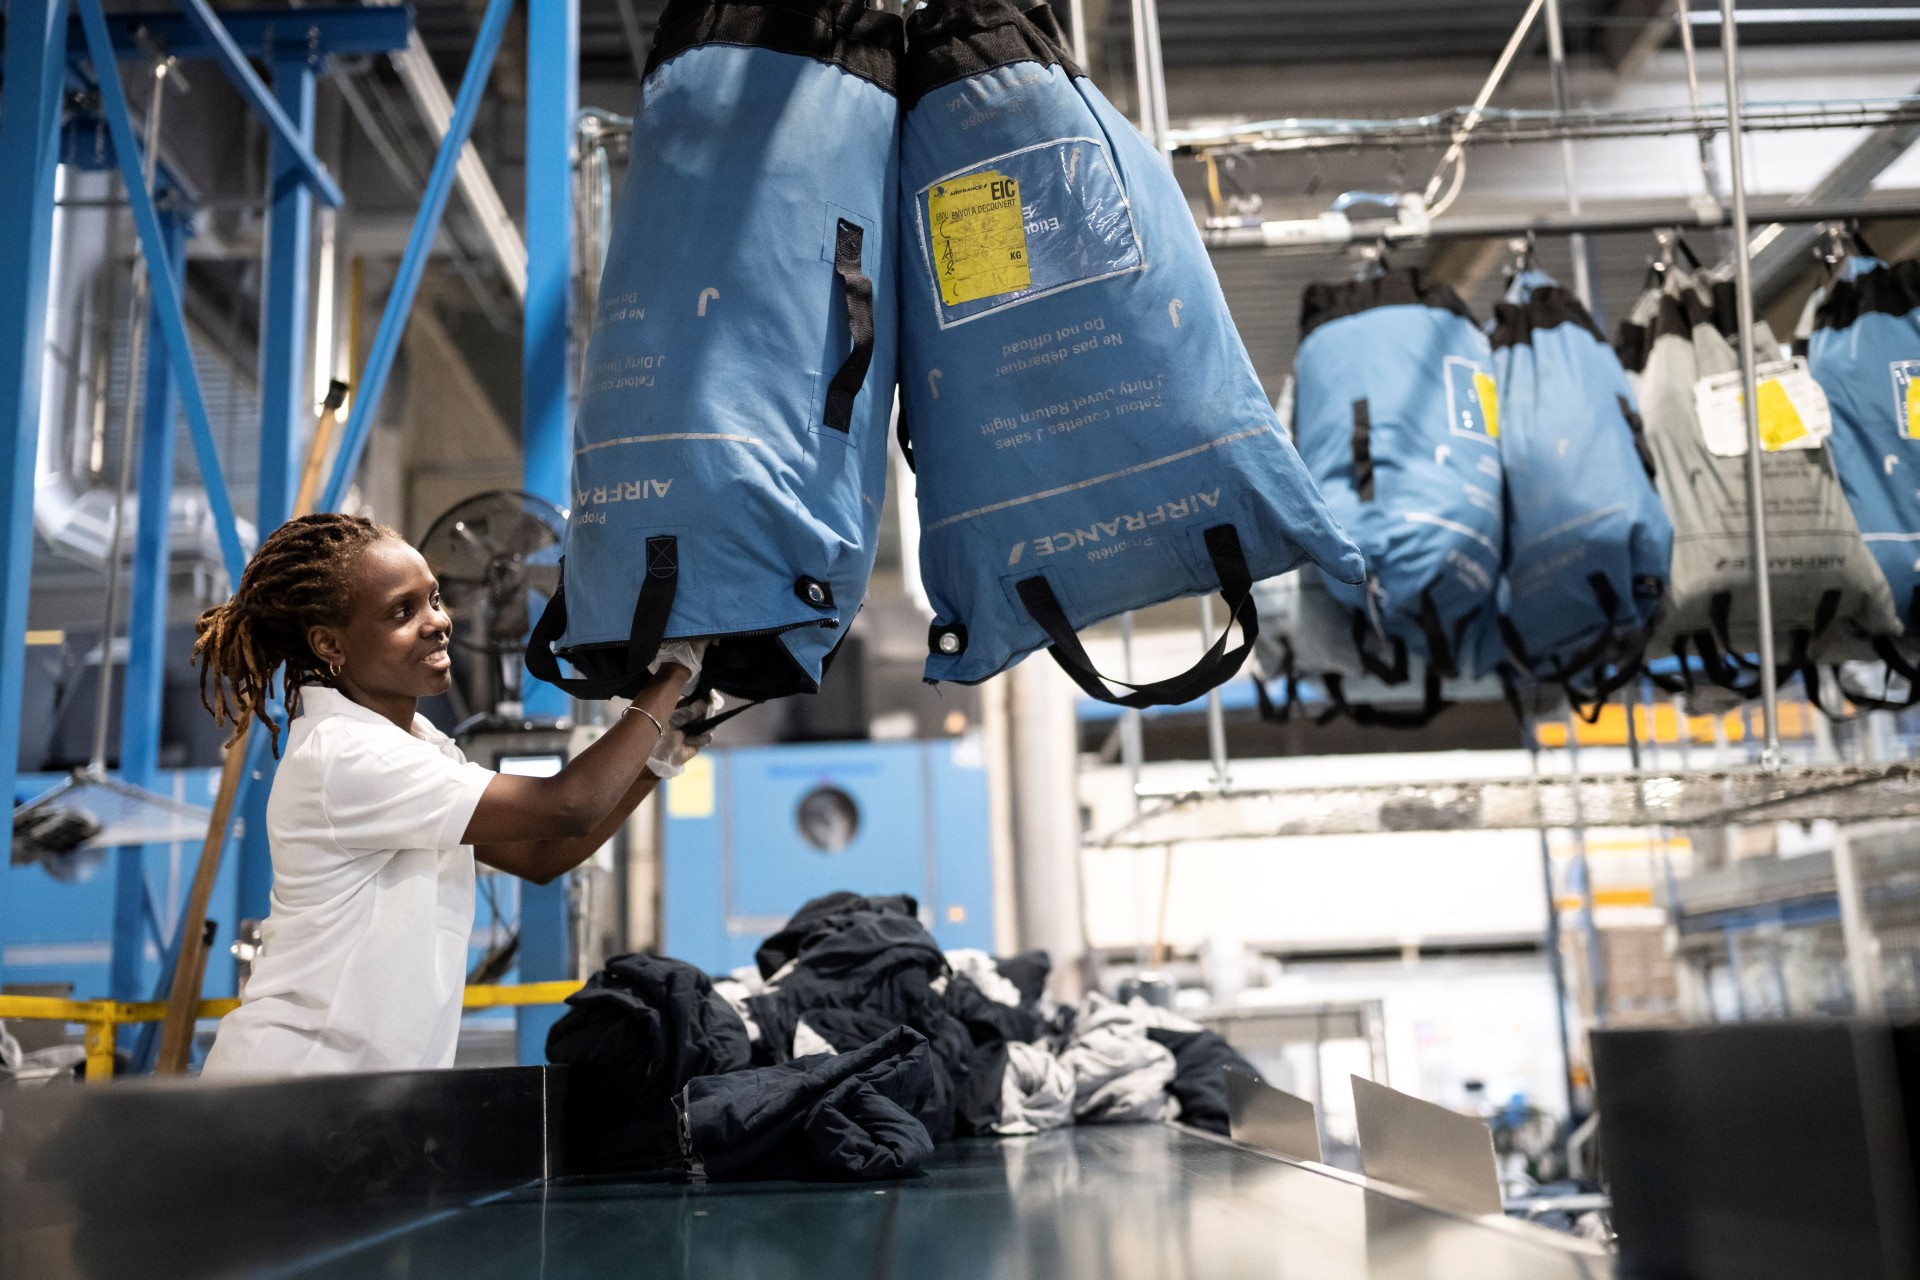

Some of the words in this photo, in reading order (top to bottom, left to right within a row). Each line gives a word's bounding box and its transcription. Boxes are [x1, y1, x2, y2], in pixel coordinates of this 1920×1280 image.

[949, 185, 982, 196] AIRFRANCE
[990, 179, 1016, 201] EIC
[951, 207, 971, 220] ENVOI
[971, 206, 978, 215] A
[977, 198, 1016, 214] DECOUVERT
[1010, 251, 1022, 260] KG
[697, 287, 720, 317] J
[628, 308, 645, 321] Ne
[1168, 299, 1183, 328] J
[1056, 325, 1081, 341] not
[1084, 318, 1106, 331] Do
[1002, 333, 1052, 358] offload
[1072, 336, 1098, 355] pas
[1103, 333, 1124, 346] Ne
[625, 355, 653, 370] Dirty
[657, 355, 666, 369] J
[928, 368, 943, 400] J
[1119, 378, 1154, 396] Dirty
[1071, 389, 1115, 411] Duvet
[1116, 394, 1164, 417] Retour
[1020, 402, 1070, 423] Return
[980, 416, 1018, 435] flight
[1048, 411, 1111, 436] couettes
[995, 432, 1033, 450] sales
[1036, 428, 1044, 442] J
[1032, 487, 1221, 557] AIRFRANCE
[1087, 537, 1154, 564] Propriété
[1733, 556, 1846, 571] AIRFRAE
